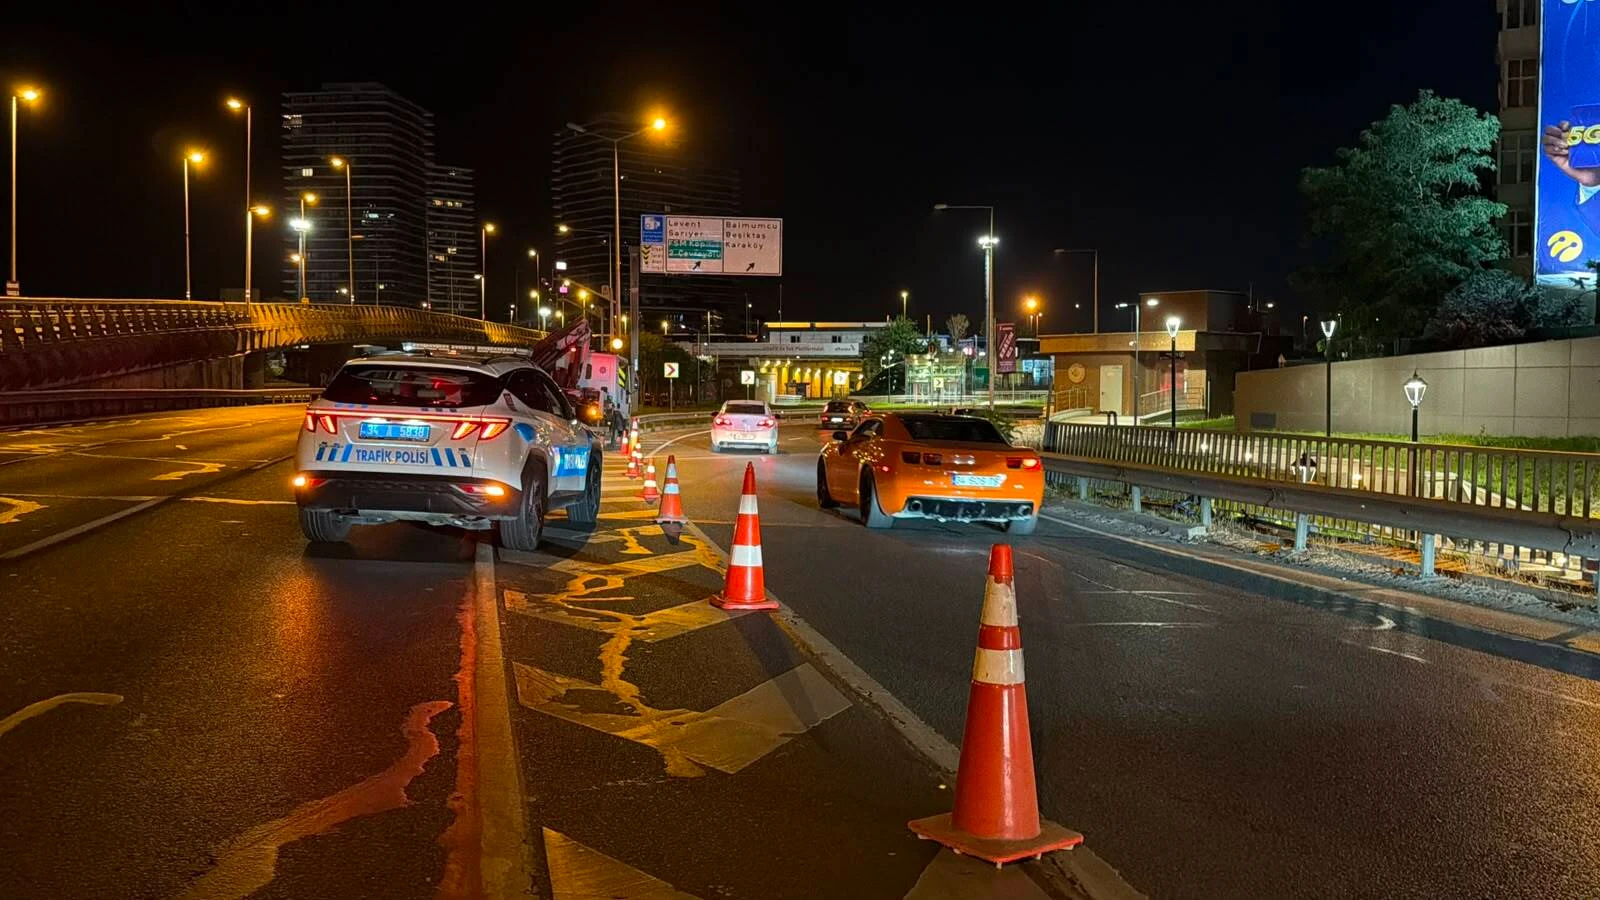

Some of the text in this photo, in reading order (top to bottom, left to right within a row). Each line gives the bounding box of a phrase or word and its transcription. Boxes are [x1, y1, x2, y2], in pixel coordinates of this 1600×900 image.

[1567, 124, 1600, 146] 5G
[668, 220, 701, 228] Levent
[725, 221, 777, 229] Balmumcu
[668, 229, 704, 238] Sarıyer
[725, 241, 763, 250] Karaköy
[356, 448, 429, 464] TRAFİK POLİSİ
